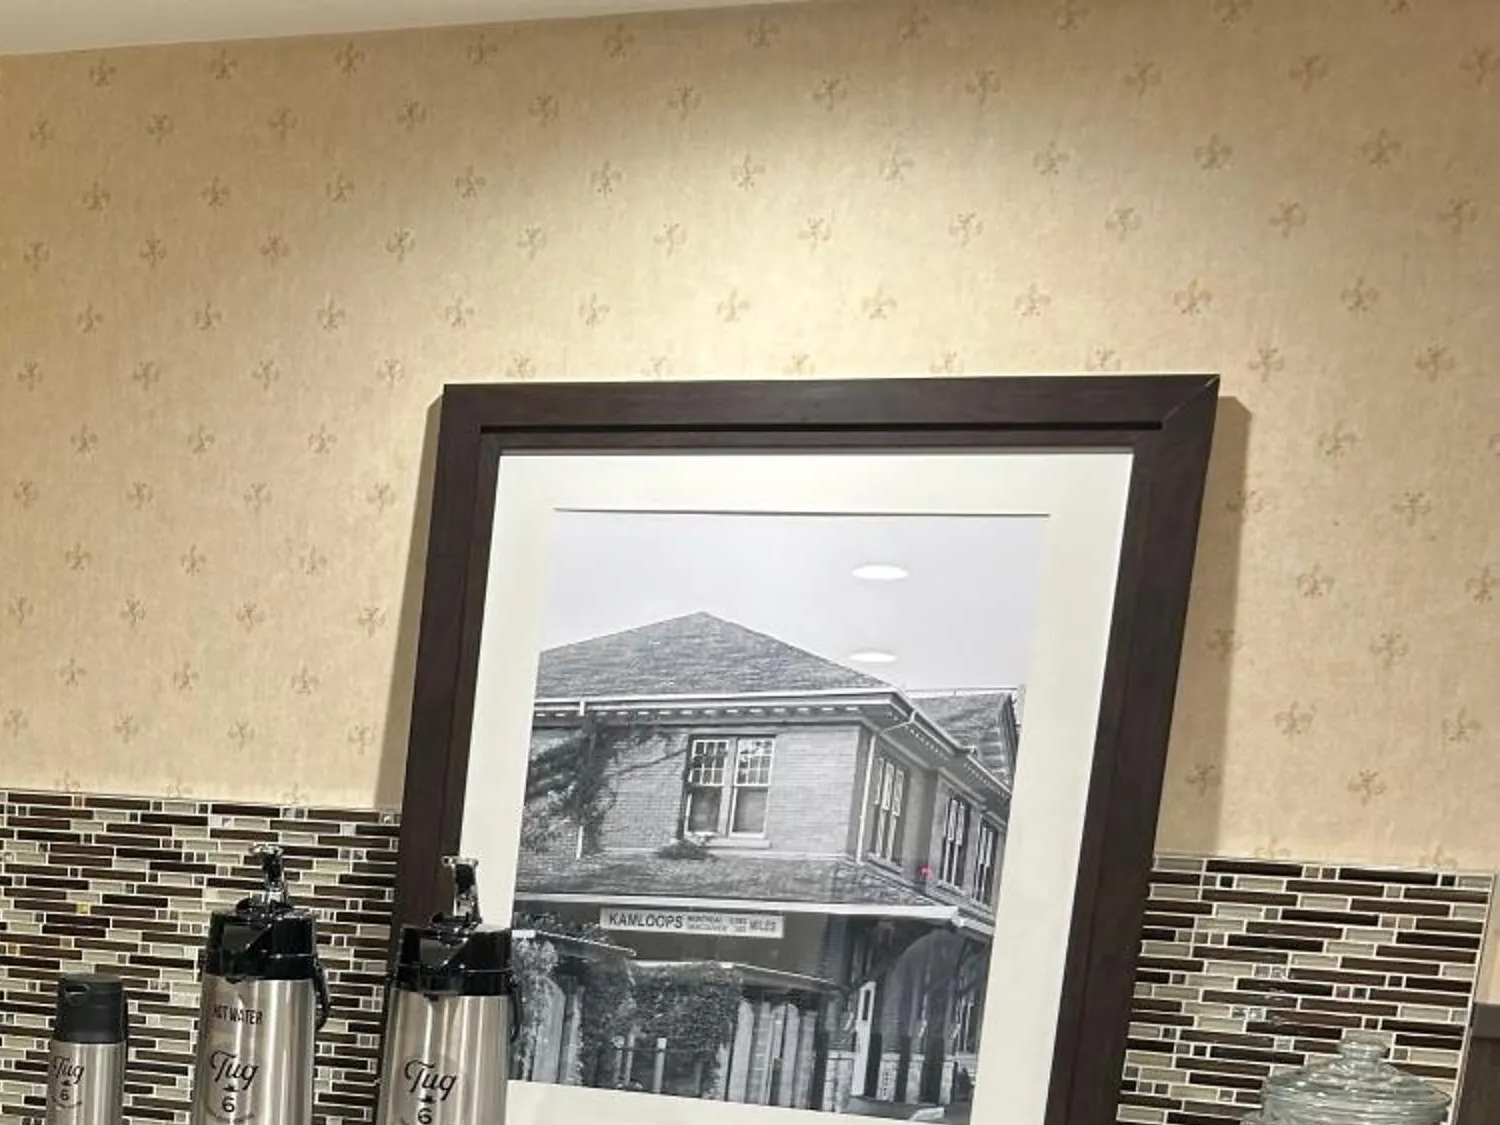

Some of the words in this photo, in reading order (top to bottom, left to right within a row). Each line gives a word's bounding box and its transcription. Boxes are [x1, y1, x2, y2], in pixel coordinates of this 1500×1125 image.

[609, 910, 684, 929] KAMLOOPS
[54, 1055, 85, 1084] Tug
[210, 1049, 260, 1091] Tug
[404, 1059, 458, 1102] Tug
[60, 1089, 70, 1102] 6
[221, 1096, 236, 1113] 6
[417, 1107, 433, 1125] 6
